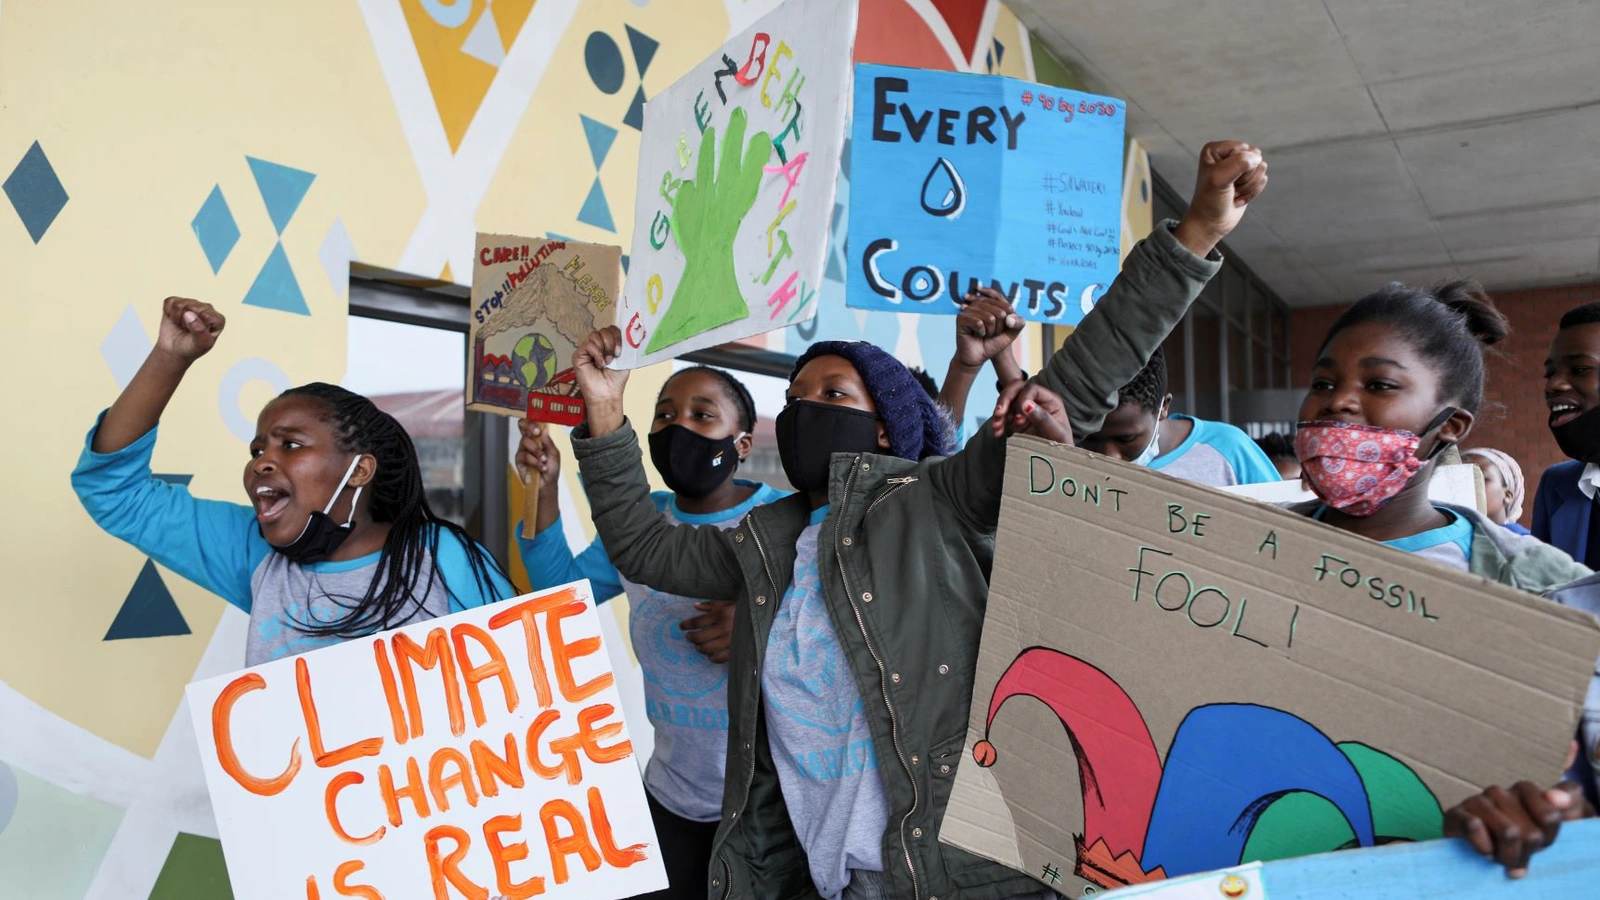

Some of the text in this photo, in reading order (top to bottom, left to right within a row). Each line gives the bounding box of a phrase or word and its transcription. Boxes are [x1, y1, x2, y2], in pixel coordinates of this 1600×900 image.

[650, 53, 738, 250] GREEN
[872, 76, 1026, 150] EVERY
[1078, 100, 1117, 117] 2030
[563, 254, 612, 313] PLEASE
[862, 238, 1068, 319] COUNTS
[1028, 455, 1440, 621] DON'T BE A FOSSIL
[211, 586, 615, 797] CLIMATE
[324, 703, 634, 847] CHANGE
[424, 786, 651, 900] REAL
